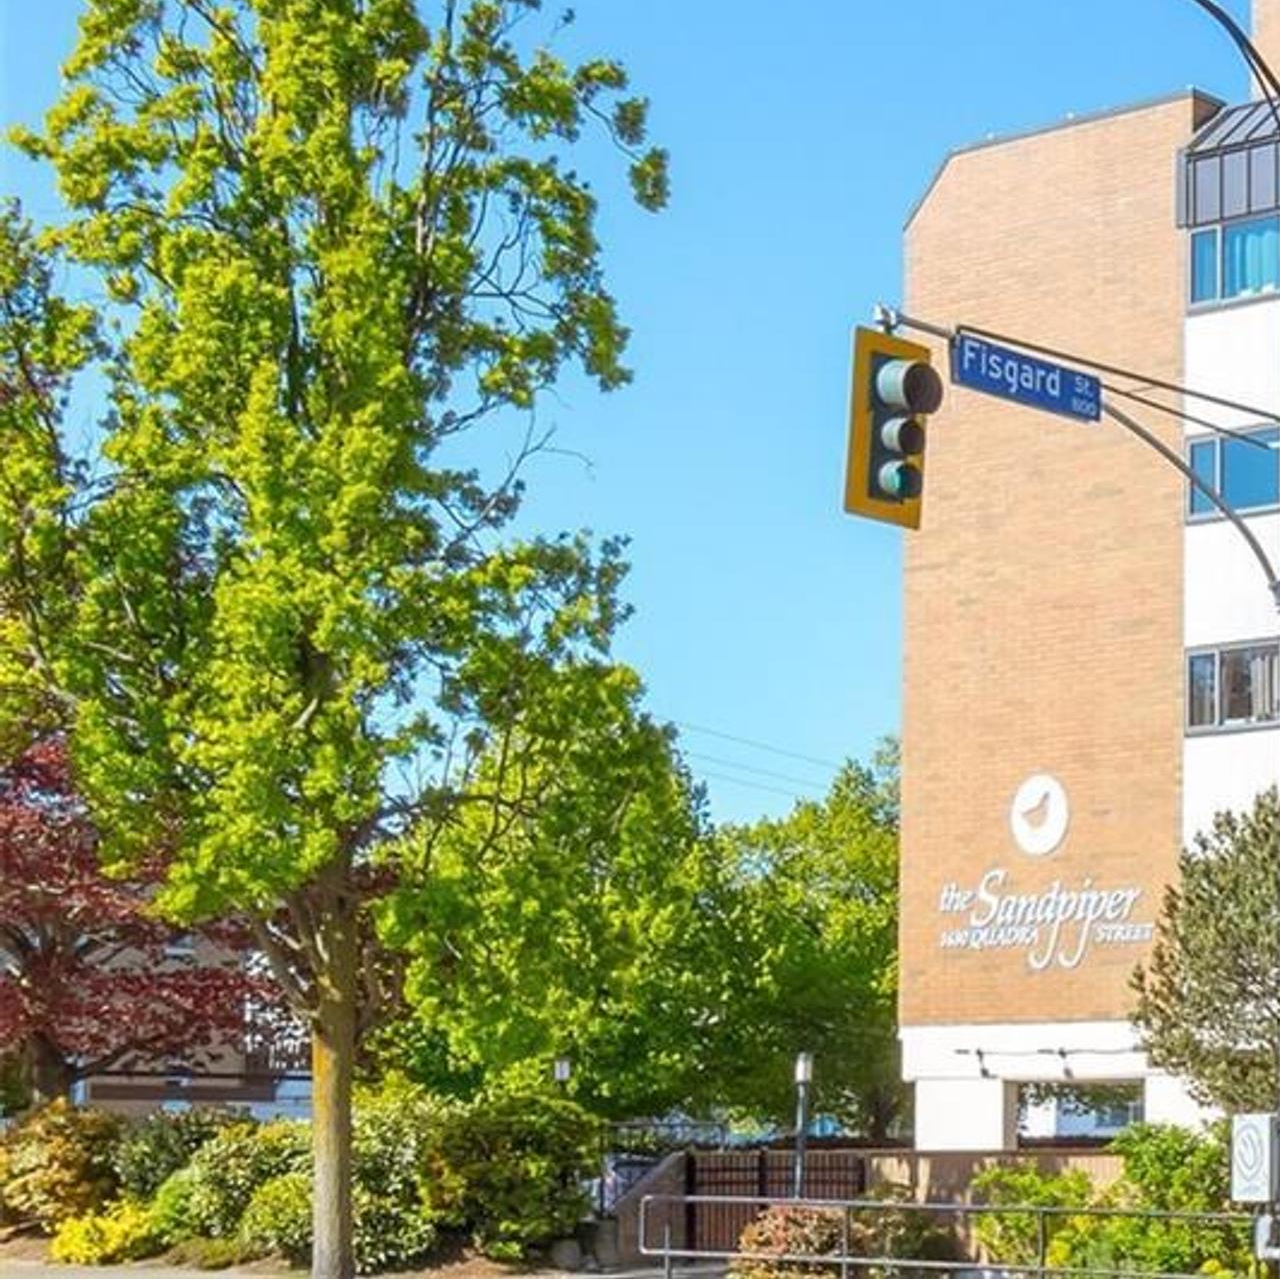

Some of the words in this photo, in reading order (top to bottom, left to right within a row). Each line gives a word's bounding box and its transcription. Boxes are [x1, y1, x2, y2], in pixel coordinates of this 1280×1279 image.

[963, 339, 1060, 397] Fisgard
[939, 882, 974, 911] the
[970, 869, 1142, 969] Sandpiper
[970, 926, 1040, 949] QUADRA
[1093, 924, 1154, 943] STREET
